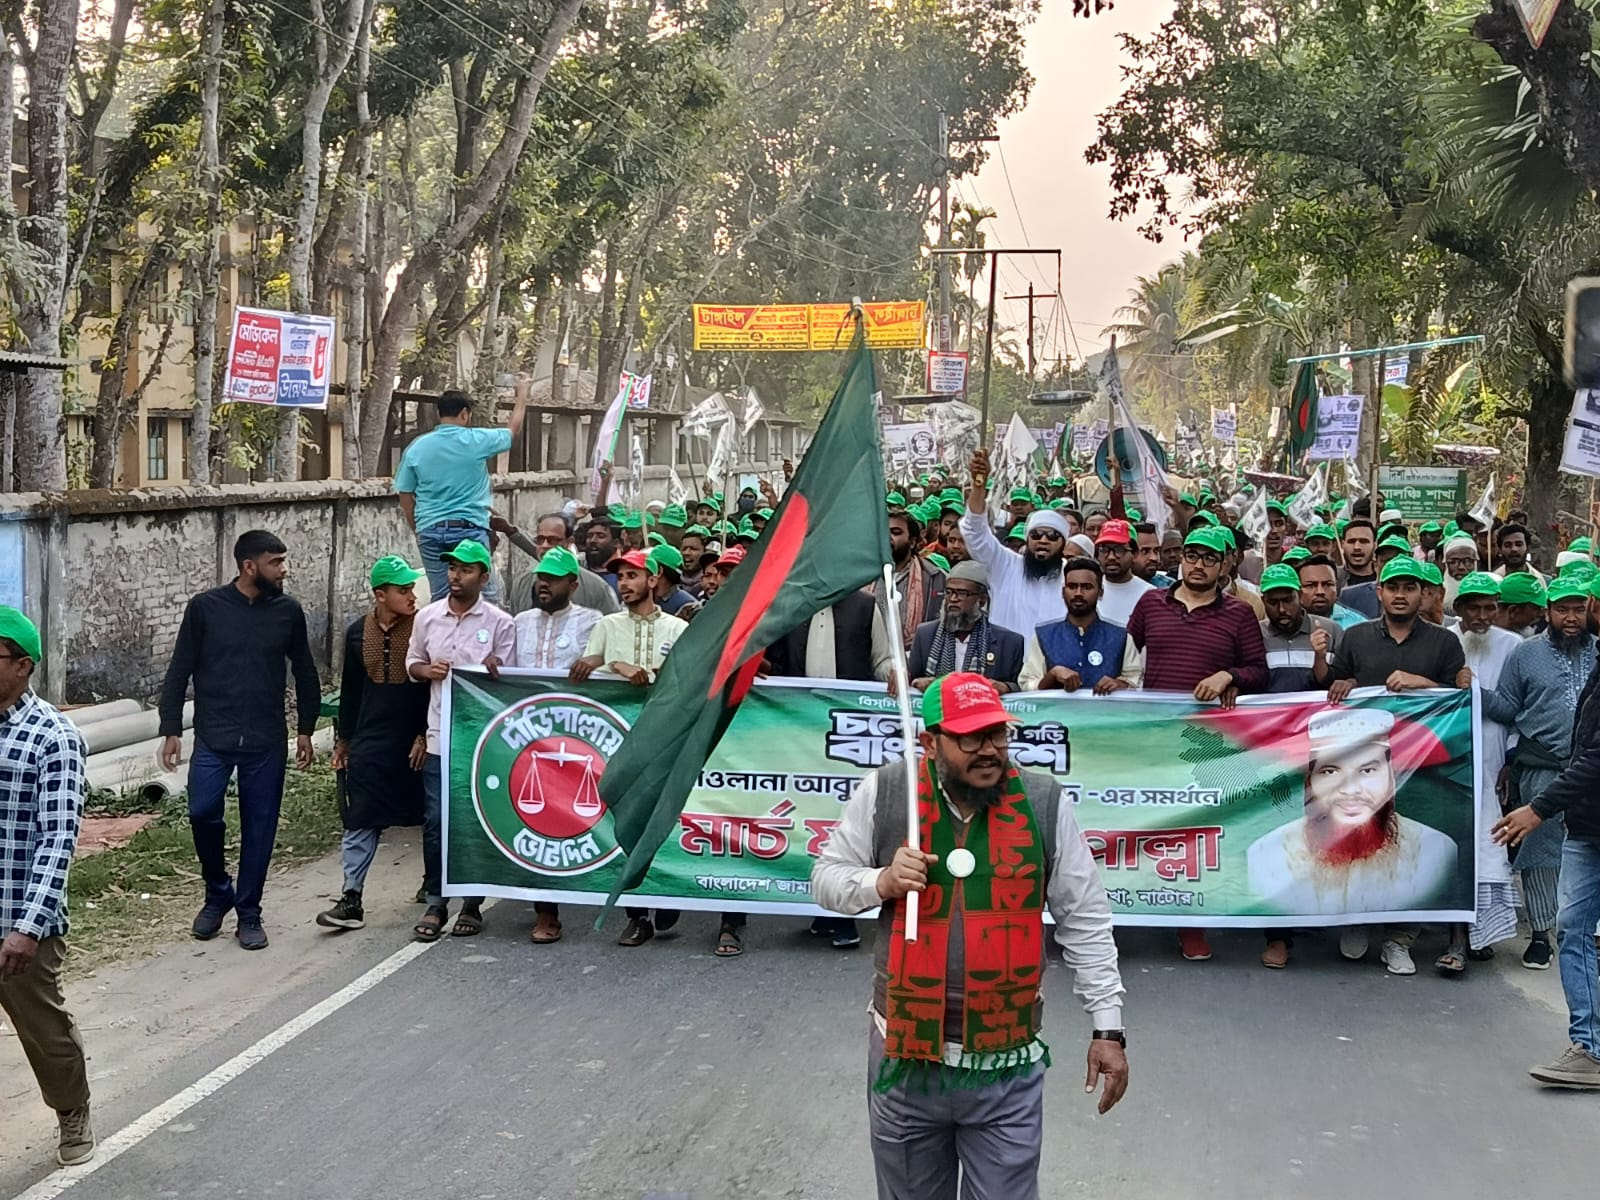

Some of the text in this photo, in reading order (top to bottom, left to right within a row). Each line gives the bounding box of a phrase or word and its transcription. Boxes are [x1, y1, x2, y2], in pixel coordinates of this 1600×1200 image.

[1425, 489, 1457, 500] শাখা
[1023, 725, 1065, 744] গড়ি
[698, 771, 863, 801] াওলানা আবু
[1141, 785, 1221, 805] সমর্থনে
[680, 800, 793, 859] মার্চ
[696, 873, 772, 892] বাংলাদেশ
